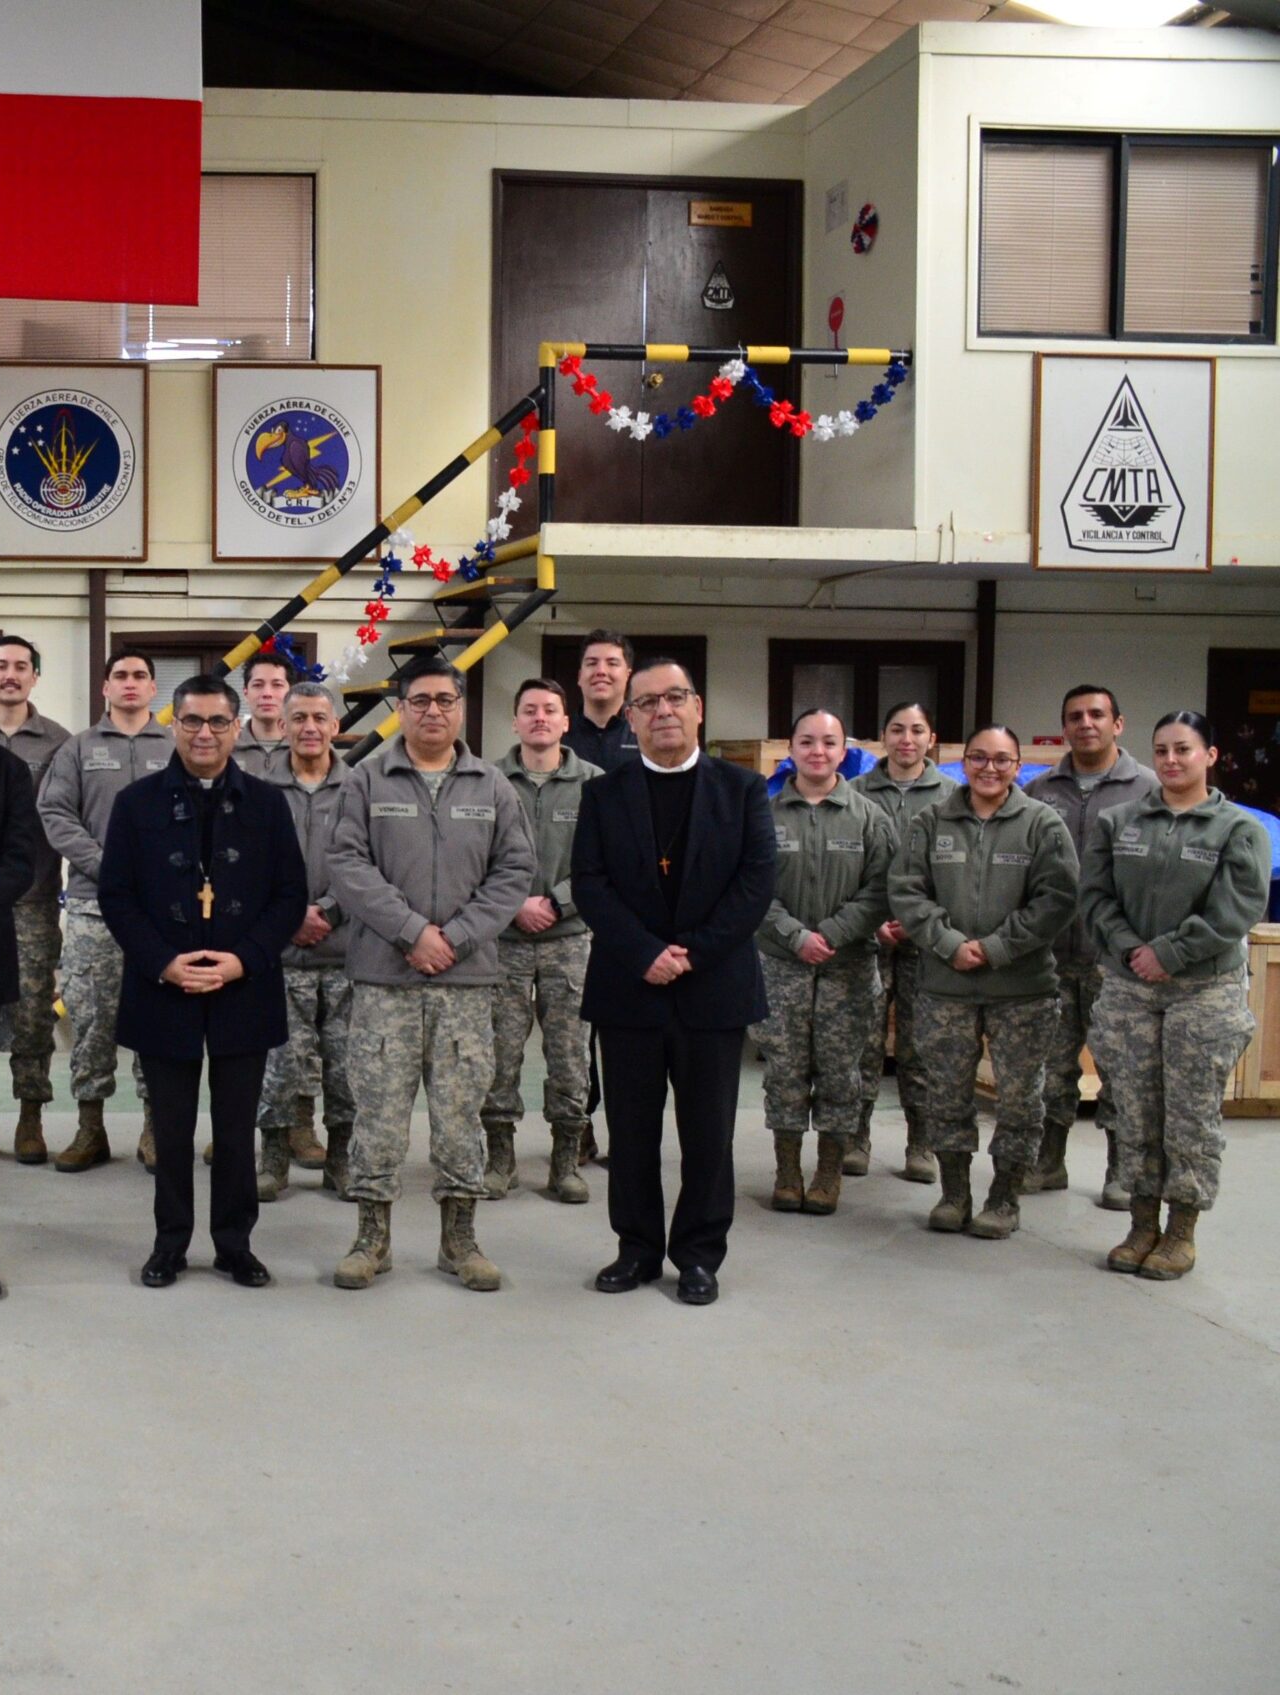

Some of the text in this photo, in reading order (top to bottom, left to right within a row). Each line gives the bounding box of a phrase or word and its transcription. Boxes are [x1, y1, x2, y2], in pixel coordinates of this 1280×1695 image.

[8, 398, 43, 426] FUERZA
[80, 396, 94, 408] DE
[94, 404, 118, 426] CHILE
[244, 400, 351, 437] FUERZA AÉREA DE CHILE
[13, 482, 112, 517] RADIO OPERADOR TERRESTRE
[240, 480, 266, 514] GRUPO
[268, 511, 282, 522] DE
[284, 517, 306, 525] TEL.
[308, 515, 315, 523] Y
[317, 505, 340, 520] DET.
[1083, 468, 1163, 503] CMTA
[0, 480, 9, 492] DE
[6, 491, 95, 527] TELECOMUNICACIONES
[1126, 531, 1131, 540] Y
[1132, 530, 1162, 540] CONTROL
